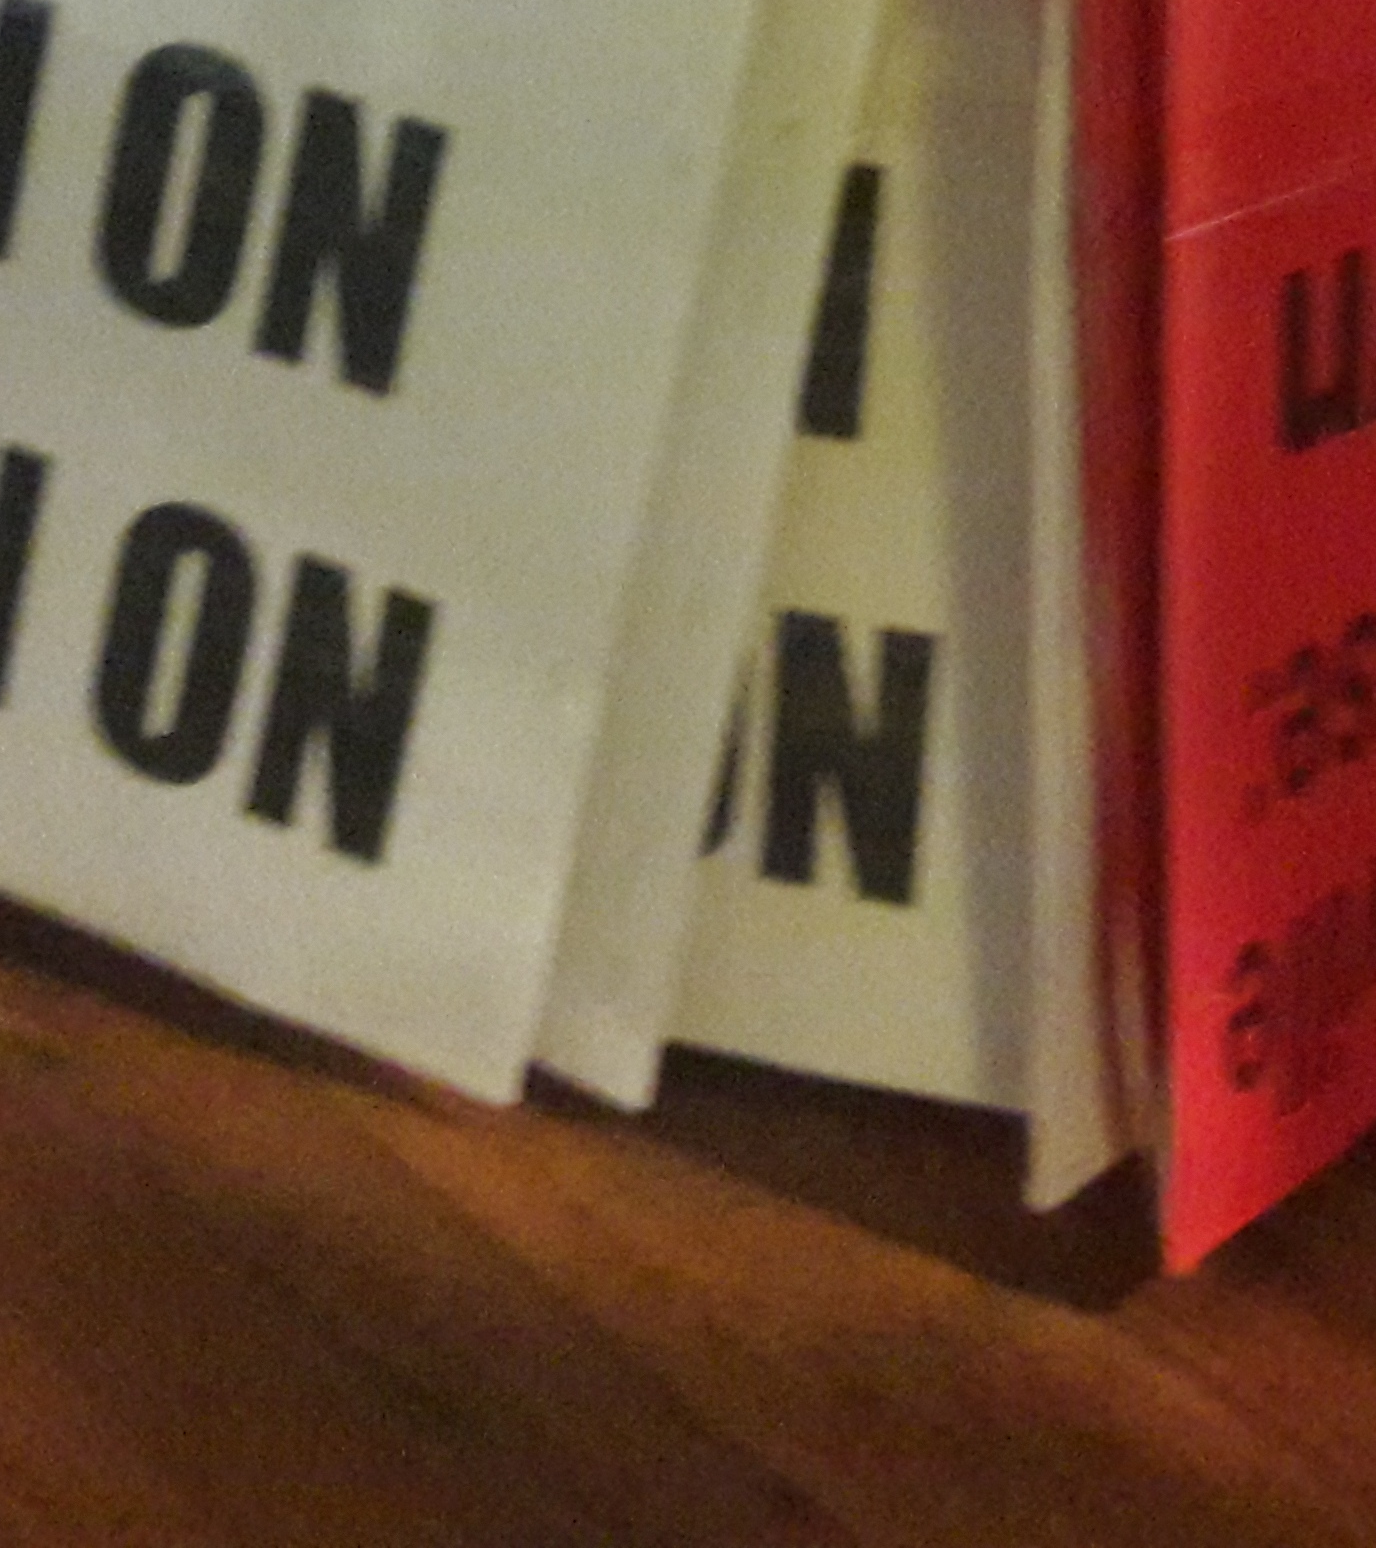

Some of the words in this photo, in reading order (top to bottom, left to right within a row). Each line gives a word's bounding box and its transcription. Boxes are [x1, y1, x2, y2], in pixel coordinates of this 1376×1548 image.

[94, 41, 451, 397] NO
[89, 500, 439, 868] NO
[702, 606, 939, 908] N
